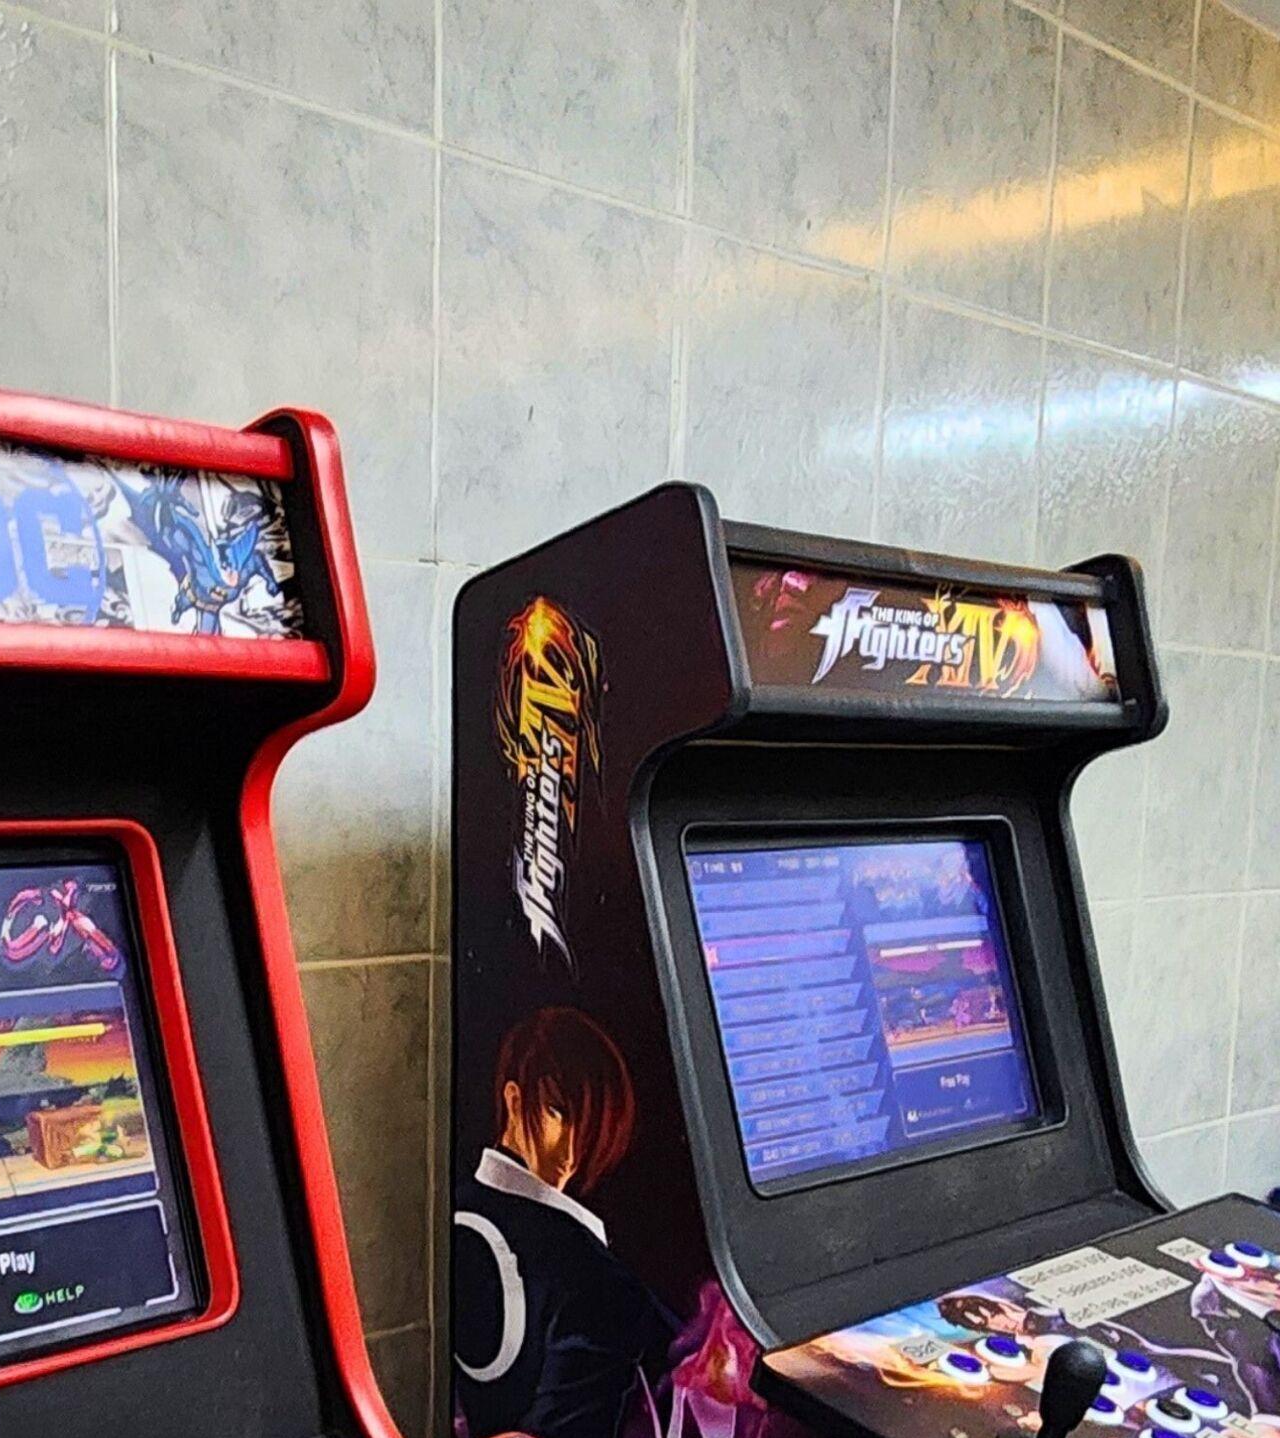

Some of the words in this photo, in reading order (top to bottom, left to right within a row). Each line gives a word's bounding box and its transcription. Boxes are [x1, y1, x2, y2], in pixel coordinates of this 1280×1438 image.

[872, 606, 894, 622] THE
[895, 609, 922, 626] KING
[923, 613, 939, 628] OF
[810, 588, 967, 684] Fighters
[525, 764, 539, 790] OF
[524, 793, 538, 833] KING
[514, 727, 571, 966] Fighters
[523, 835, 537, 862] THE
[45, 1283, 85, 1306] HELP
